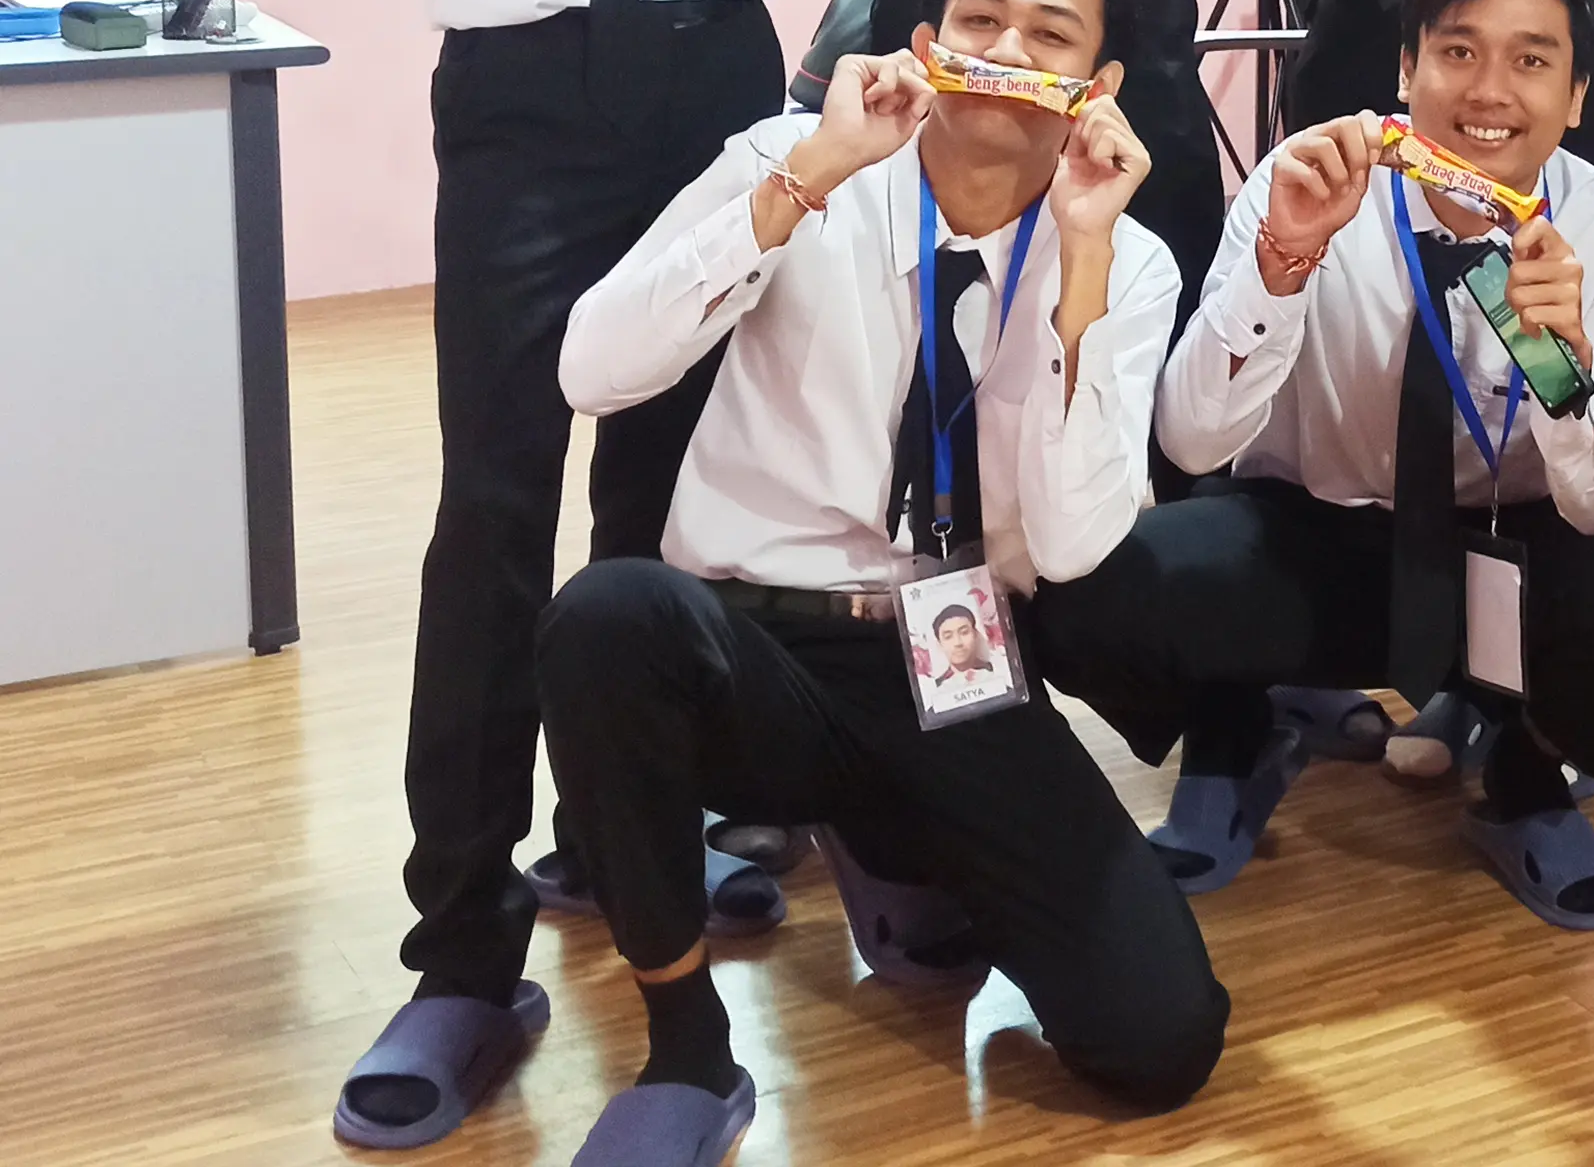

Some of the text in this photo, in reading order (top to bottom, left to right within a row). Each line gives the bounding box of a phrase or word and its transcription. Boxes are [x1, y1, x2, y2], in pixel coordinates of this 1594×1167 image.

[966, 73, 1041, 97] beng-beng
[1423, 158, 1493, 199] beng-beng
[954, 687, 986, 703] SATYA
